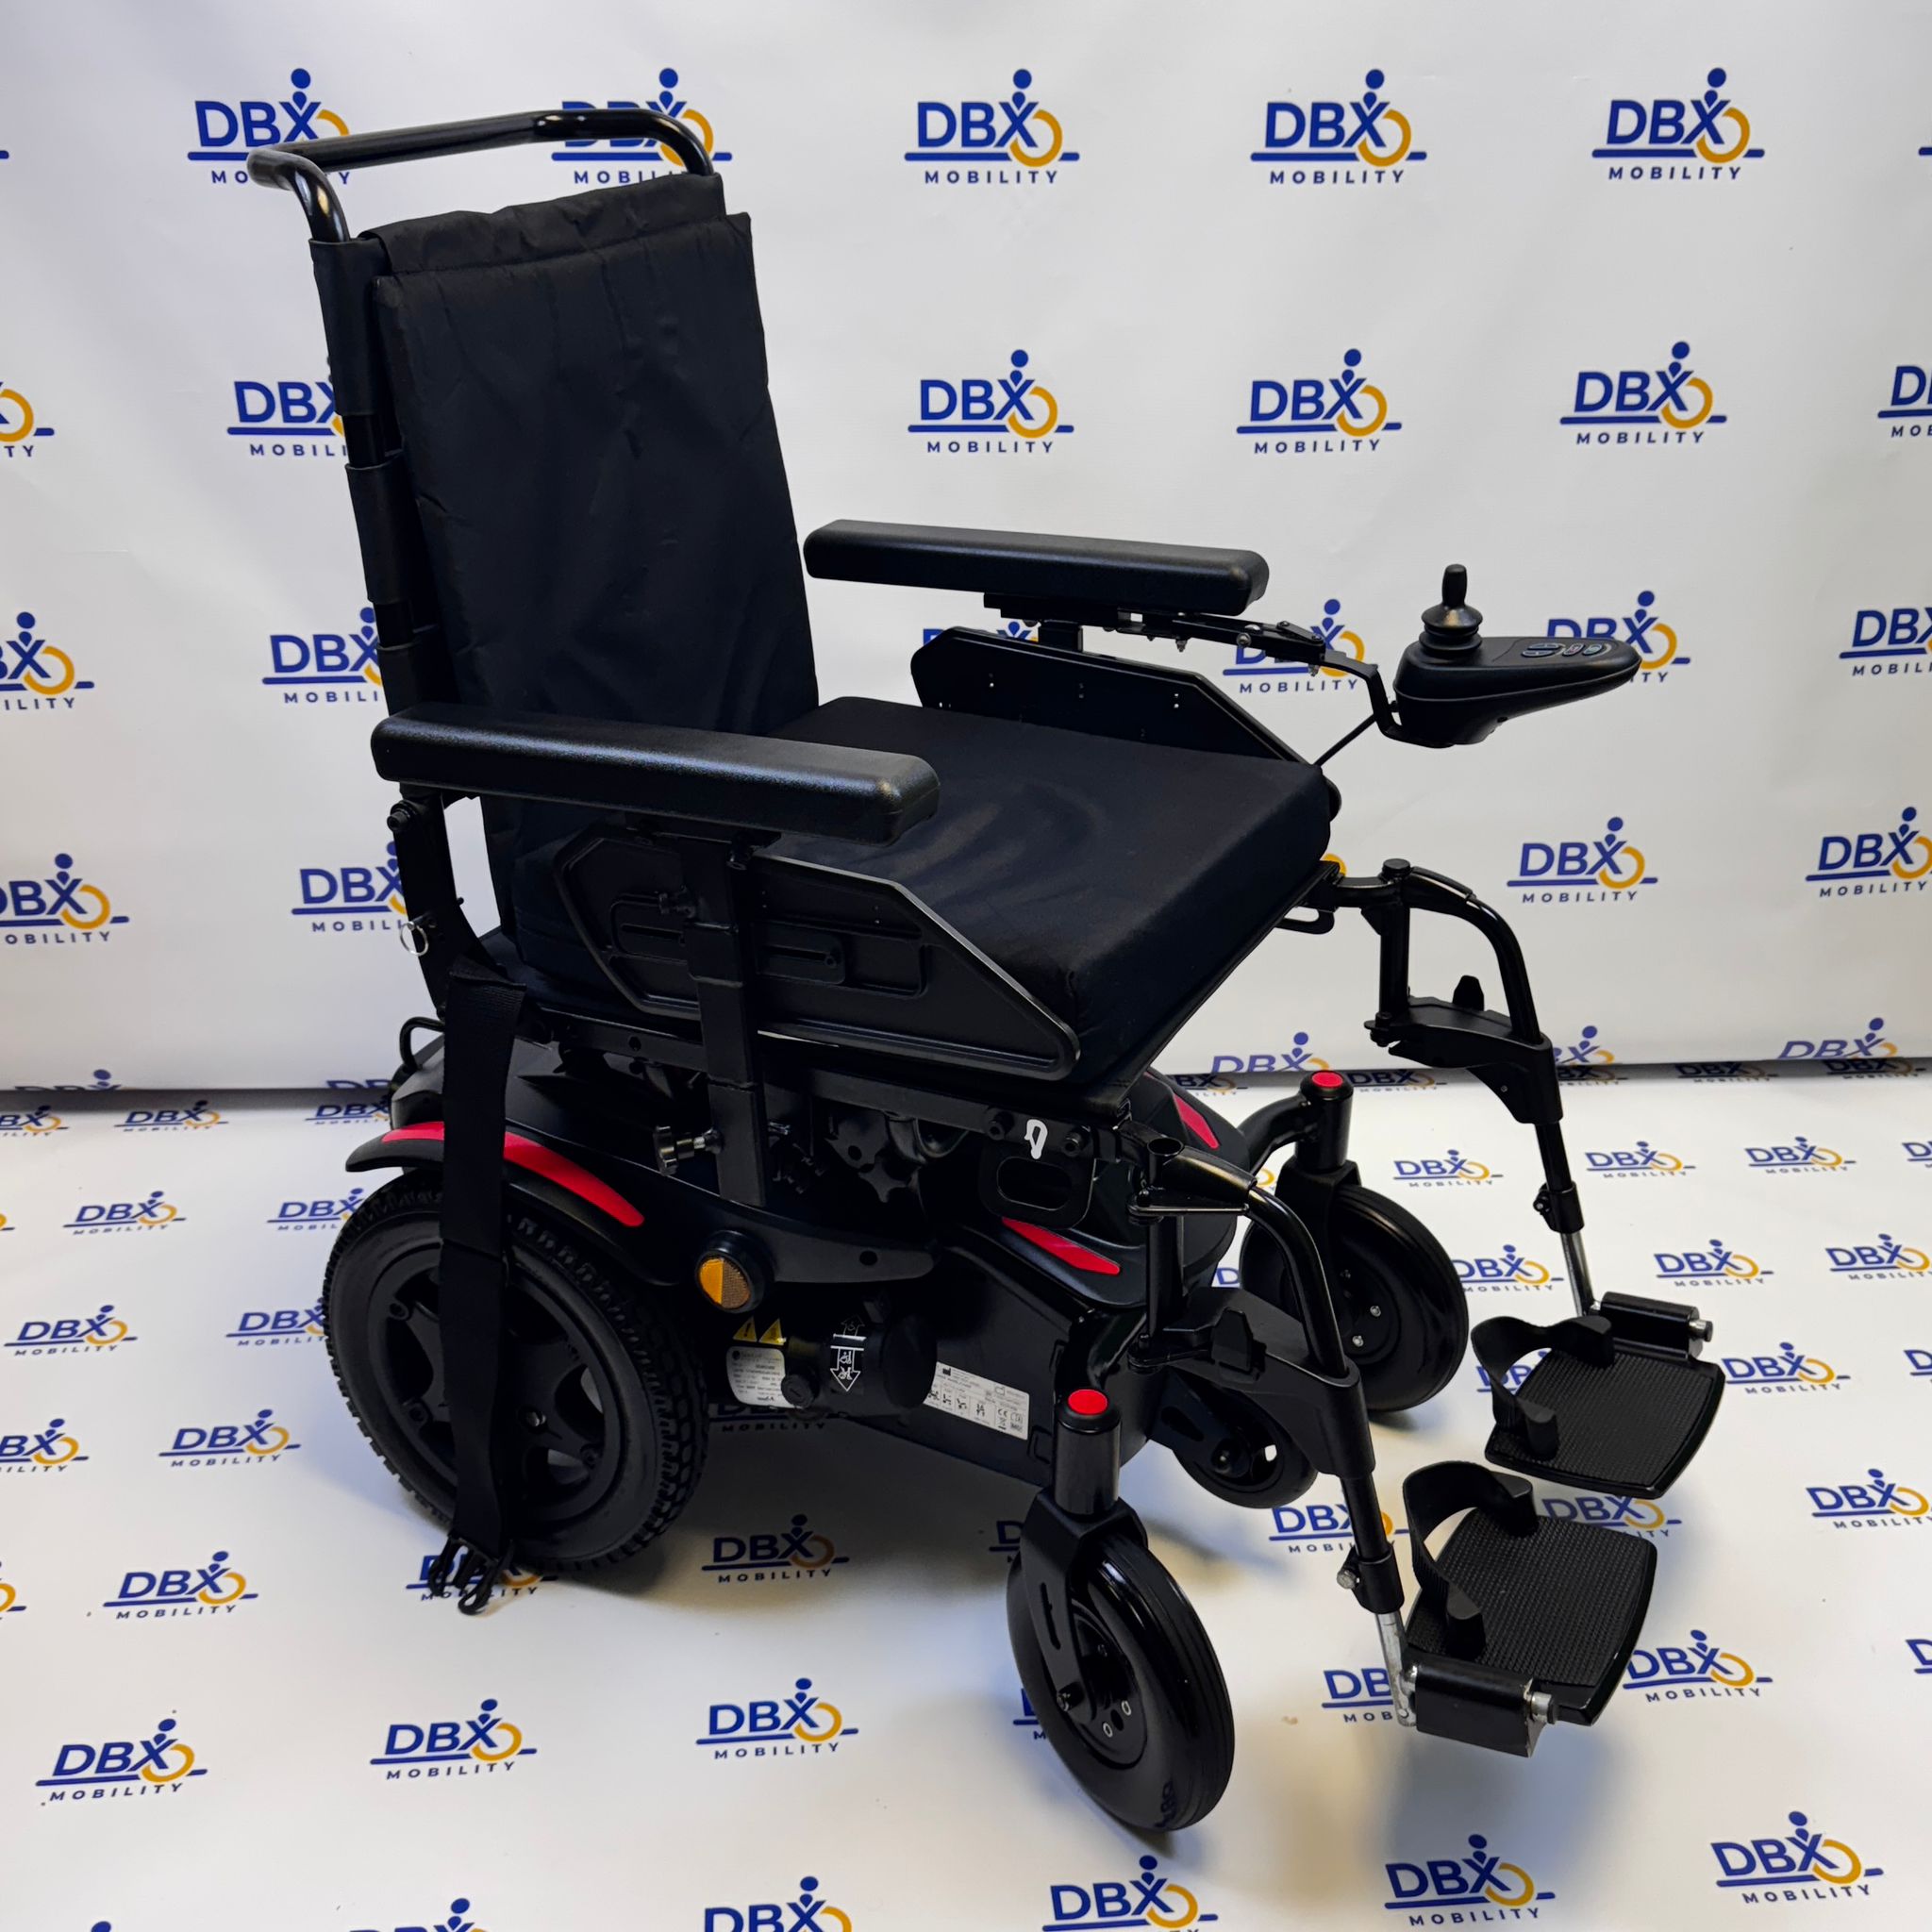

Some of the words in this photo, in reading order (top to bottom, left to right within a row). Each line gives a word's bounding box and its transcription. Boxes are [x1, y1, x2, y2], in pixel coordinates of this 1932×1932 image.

[194, 101, 322, 147] DBX
[918, 102, 1038, 147] DBX
[1265, 102, 1389, 148] DBX
[1607, 100, 1730, 144] DBX
[925, 171, 1057, 183] MOBILITY
[1271, 171, 1403, 184] MOBILITY
[1609, 167, 1740, 179] MOBILITY
[921, 379, 1034, 420] DBX
[1251, 378, 1366, 422] DBX
[1574, 371, 1692, 412] DBX
[927, 441, 1052, 453] MOBILITY
[1255, 440, 1379, 453] MOBILITY
[1577, 432, 1703, 444] MOBILITY
[250, 444, 347, 457] MOBILI
[1240, 679, 1357, 693] MOBILITY
[5, 697, 75, 710] ILITY
[284, 691, 378, 704] MOBILI
[1520, 841, 1627, 875] DBX
[1819, 831, 1919, 871] DBX
[0, 878, 87, 916] BX
[1523, 891, 1637, 903] MOBILITY
[1820, 881, 1926, 897] MOBILITY
[312, 920, 403, 932] MOBILI
[5, 932, 109, 944] OBILITY
[1778, 1038, 1885, 1058] DBX
[0, 1114, 49, 1126] BX
[125, 1109, 207, 1124] DBX
[1586, 1149, 1664, 1168] DBX
[1745, 1146, 1826, 1162] DBX
[1394, 1159, 1473, 1176] DBX
[75, 1202, 164, 1223] DBX
[278, 1199, 364, 1219] DBX
[1654, 1252, 1741, 1273] DBX
[1825, 1244, 1914, 1266] DBX
[1452, 1257, 1533, 1278] DBX
[17, 1318, 114, 1341] DBX
[239, 1310, 325, 1330] DBX
[15, 1345, 116, 1356] MOBILITY
[238, 1336, 325, 1346] MOBILIT
[1722, 1356, 1816, 1378] DBX
[1745, 1384, 1840, 1393] MOBILITY
[0, 1433, 64, 1457] BX
[173, 1423, 275, 1450] DBX
[172, 1455, 279, 1466] MOBILITY
[1807, 1484, 1909, 1510] DBX
[713, 1530, 813, 1562] DBX
[118, 1569, 229, 1598] DBX
[719, 1568, 831, 1582] MOBILITY
[117, 1606, 235, 1619] MOBILITY
[1627, 1648, 1733, 1679] DBX
[1324, 1668, 1391, 1699] DB
[1645, 1688, 1758, 1702] MOBILITY
[709, 1698, 819, 1735] DBX
[385, 1719, 501, 1755] DBX
[53, 1739, 177, 1776] DBX
[715, 1742, 838, 1758] MOBILITY
[387, 1762, 513, 1779] MOBILITY
[50, 1783, 181, 1801] MOBILITY
[1710, 1832, 1835, 1874] DBX
[1385, 1856, 1505, 1900] DBX
[1051, 1878, 1174, 1921] DBX
[1742, 1885, 1869, 1903] MOBILITY
[1409, 1908, 1538, 1925] MOBILITY
